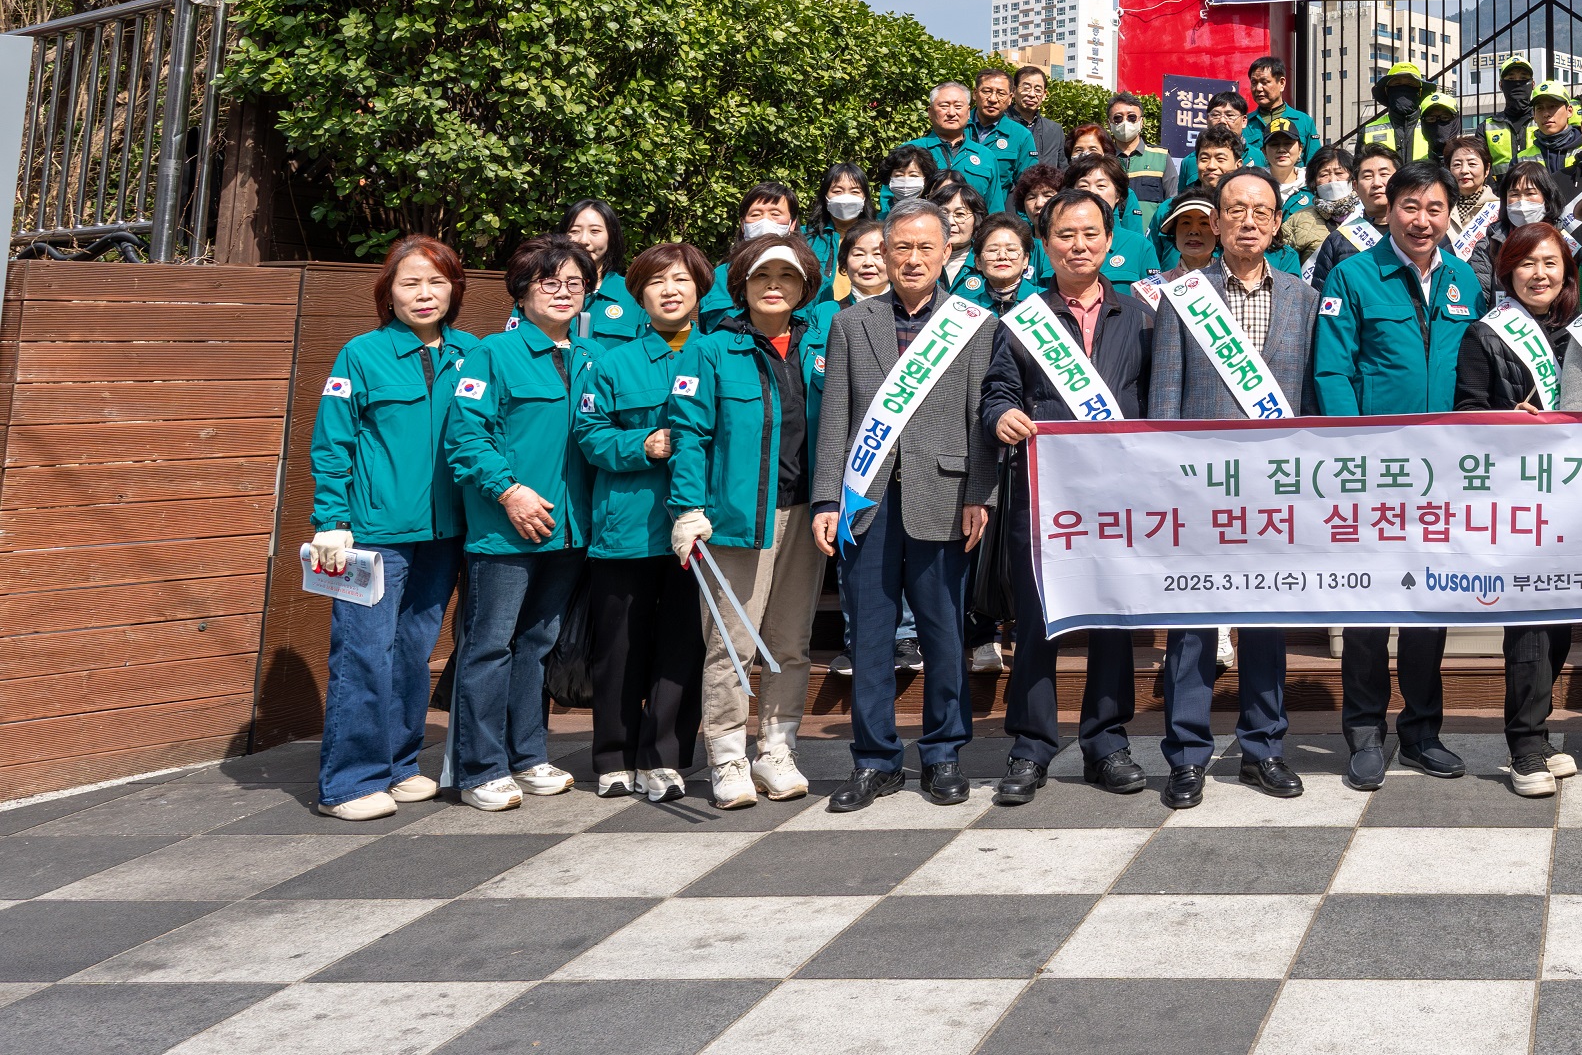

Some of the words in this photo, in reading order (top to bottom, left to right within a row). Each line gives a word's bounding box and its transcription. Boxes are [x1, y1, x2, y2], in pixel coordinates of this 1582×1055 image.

[1176, 110, 1208, 129] 버스
[1270, 118, 1291, 133] 27
[1454, 239, 1465, 250] 내
[1462, 210, 1490, 240] 쓰레기는
[882, 316, 964, 415] 도시환경
[1014, 306, 1091, 392] 도시환경
[1187, 295, 1263, 392] 도시환경
[851, 417, 893, 478] 정비
[1267, 455, 1433, 499] 집(점포)
[1457, 453, 1496, 494] 앞
[1047, 507, 1186, 551] 우리가
[1212, 503, 1296, 547] 먼저
[1331, 501, 1565, 546] 실천합니다.
[1163, 571, 1309, 593] 2025.3.12.(수)
[1315, 572, 1372, 590] 13:00
[1426, 566, 1506, 600] busanjin
